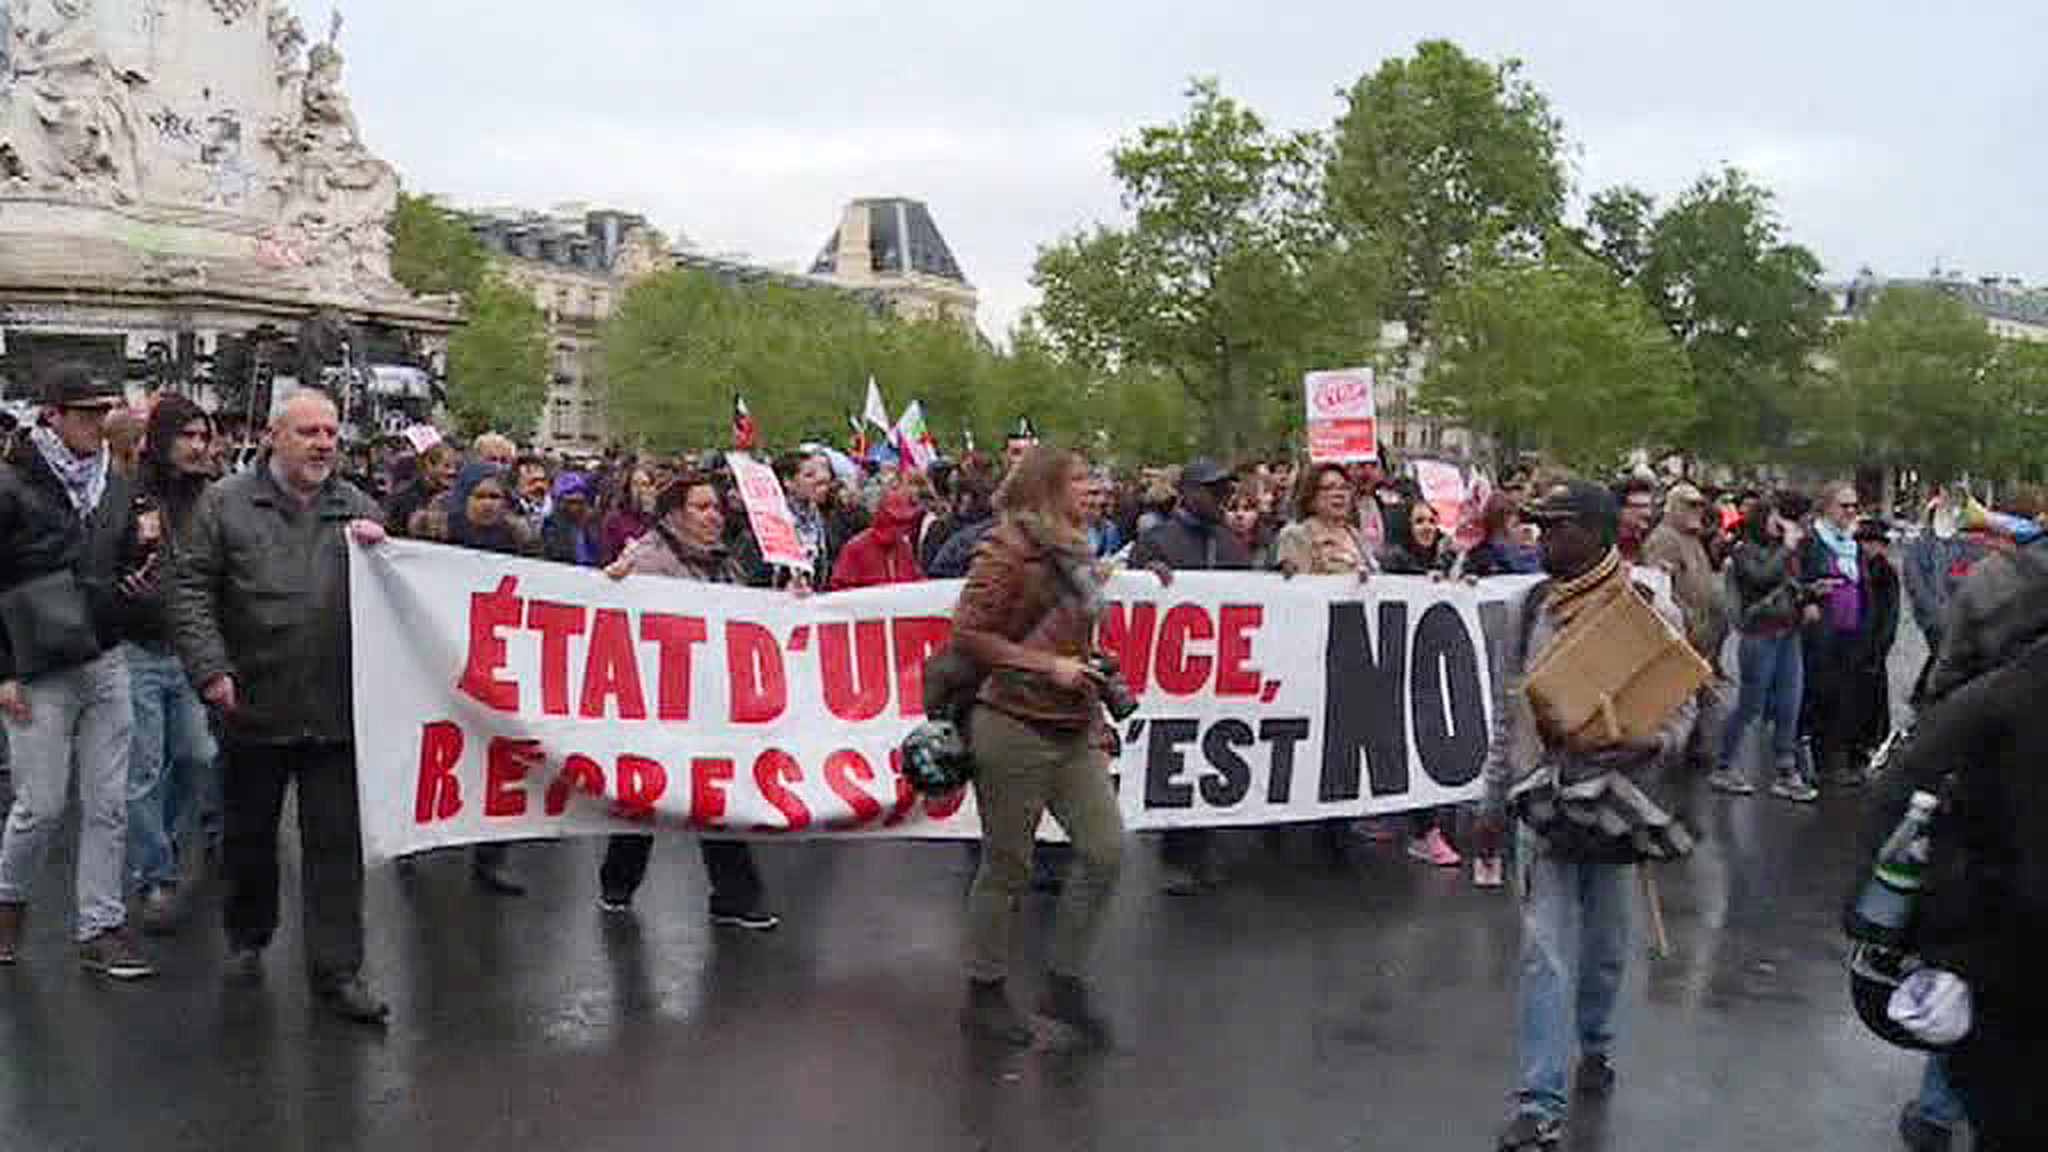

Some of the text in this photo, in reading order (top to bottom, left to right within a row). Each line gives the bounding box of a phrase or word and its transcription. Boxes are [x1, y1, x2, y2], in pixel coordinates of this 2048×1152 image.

[457, 574, 1281, 724] ÉTAT D'URNCE,
[1318, 598, 1504, 803] NO
[1112, 717, 1309, 809] 'EST
